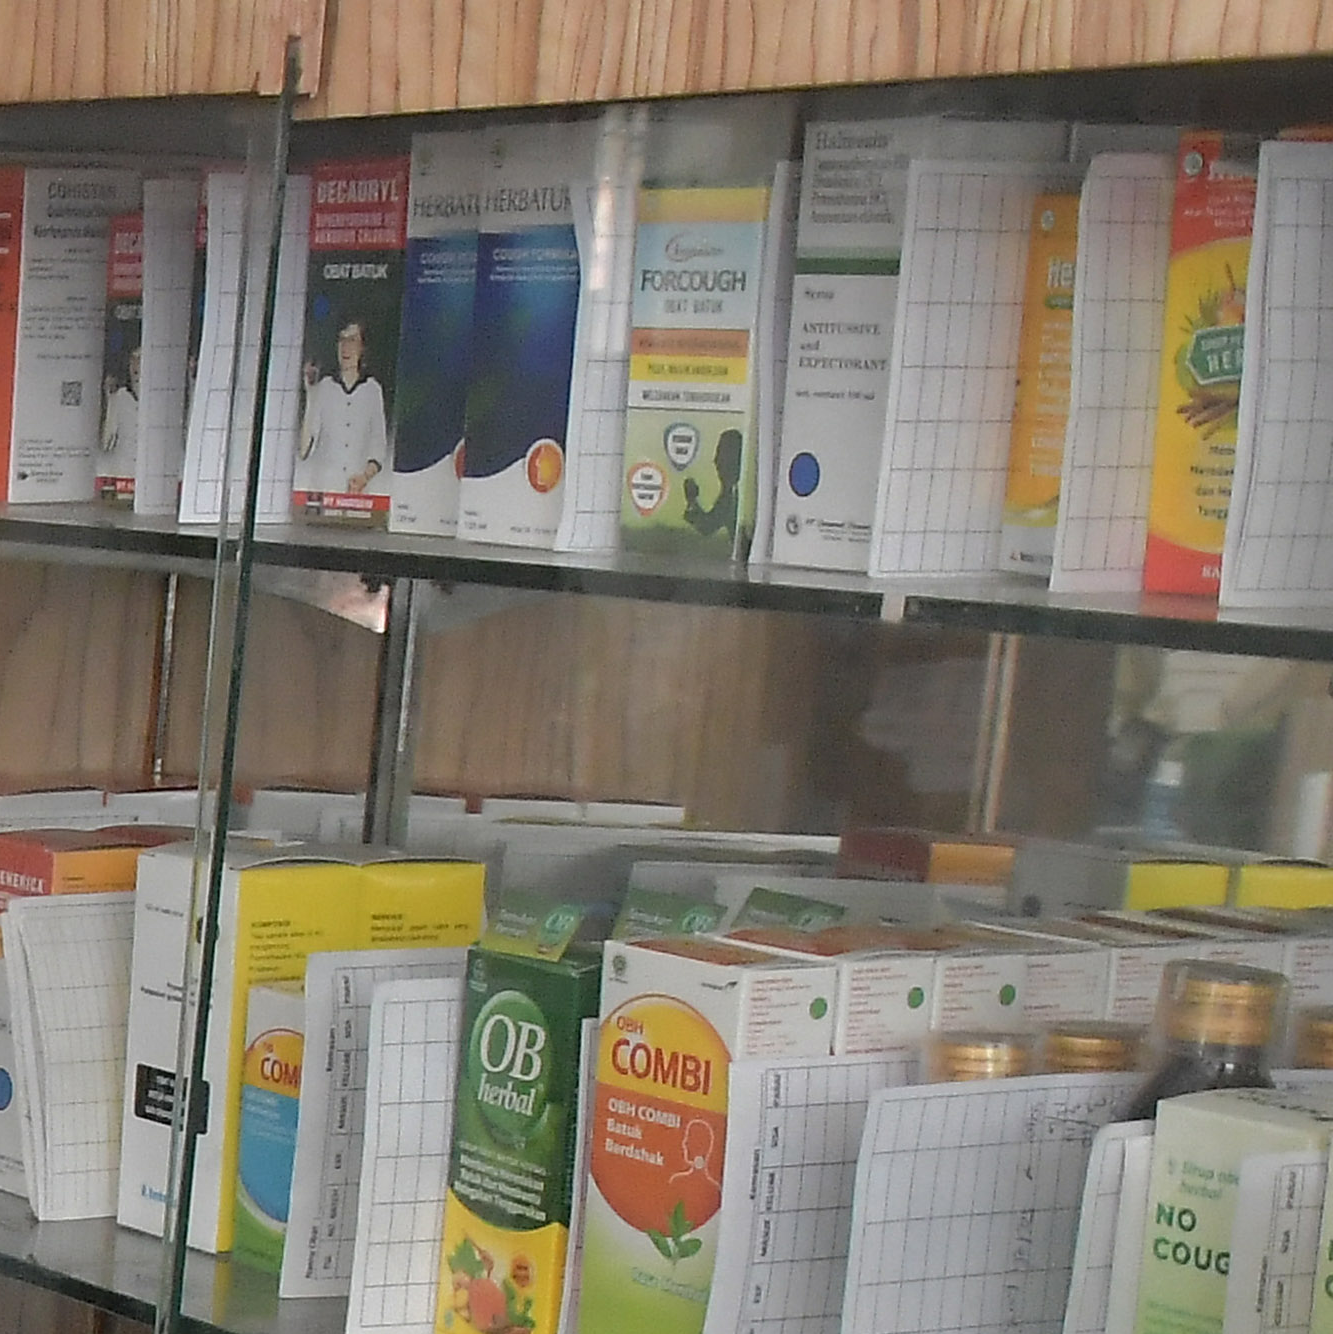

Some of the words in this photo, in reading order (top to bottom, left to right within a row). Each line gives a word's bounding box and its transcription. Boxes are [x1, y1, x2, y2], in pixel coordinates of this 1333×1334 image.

[641, 270, 747, 292] FORCOUGH
[802, 323, 881, 335] ANTITUSSIVE
[799, 358, 887, 371] EXPECTORANT
[616, 1014, 644, 1036] OBH
[480, 1013, 546, 1081] OB
[260, 1057, 303, 1087] COM
[610, 1038, 712, 1096] COMBI
[478, 1073, 536, 1116] herbal
[638, 1106, 682, 1129] COMBI
[1156, 1202, 1197, 1233] NO
[1153, 1237, 1231, 1276] COUG
